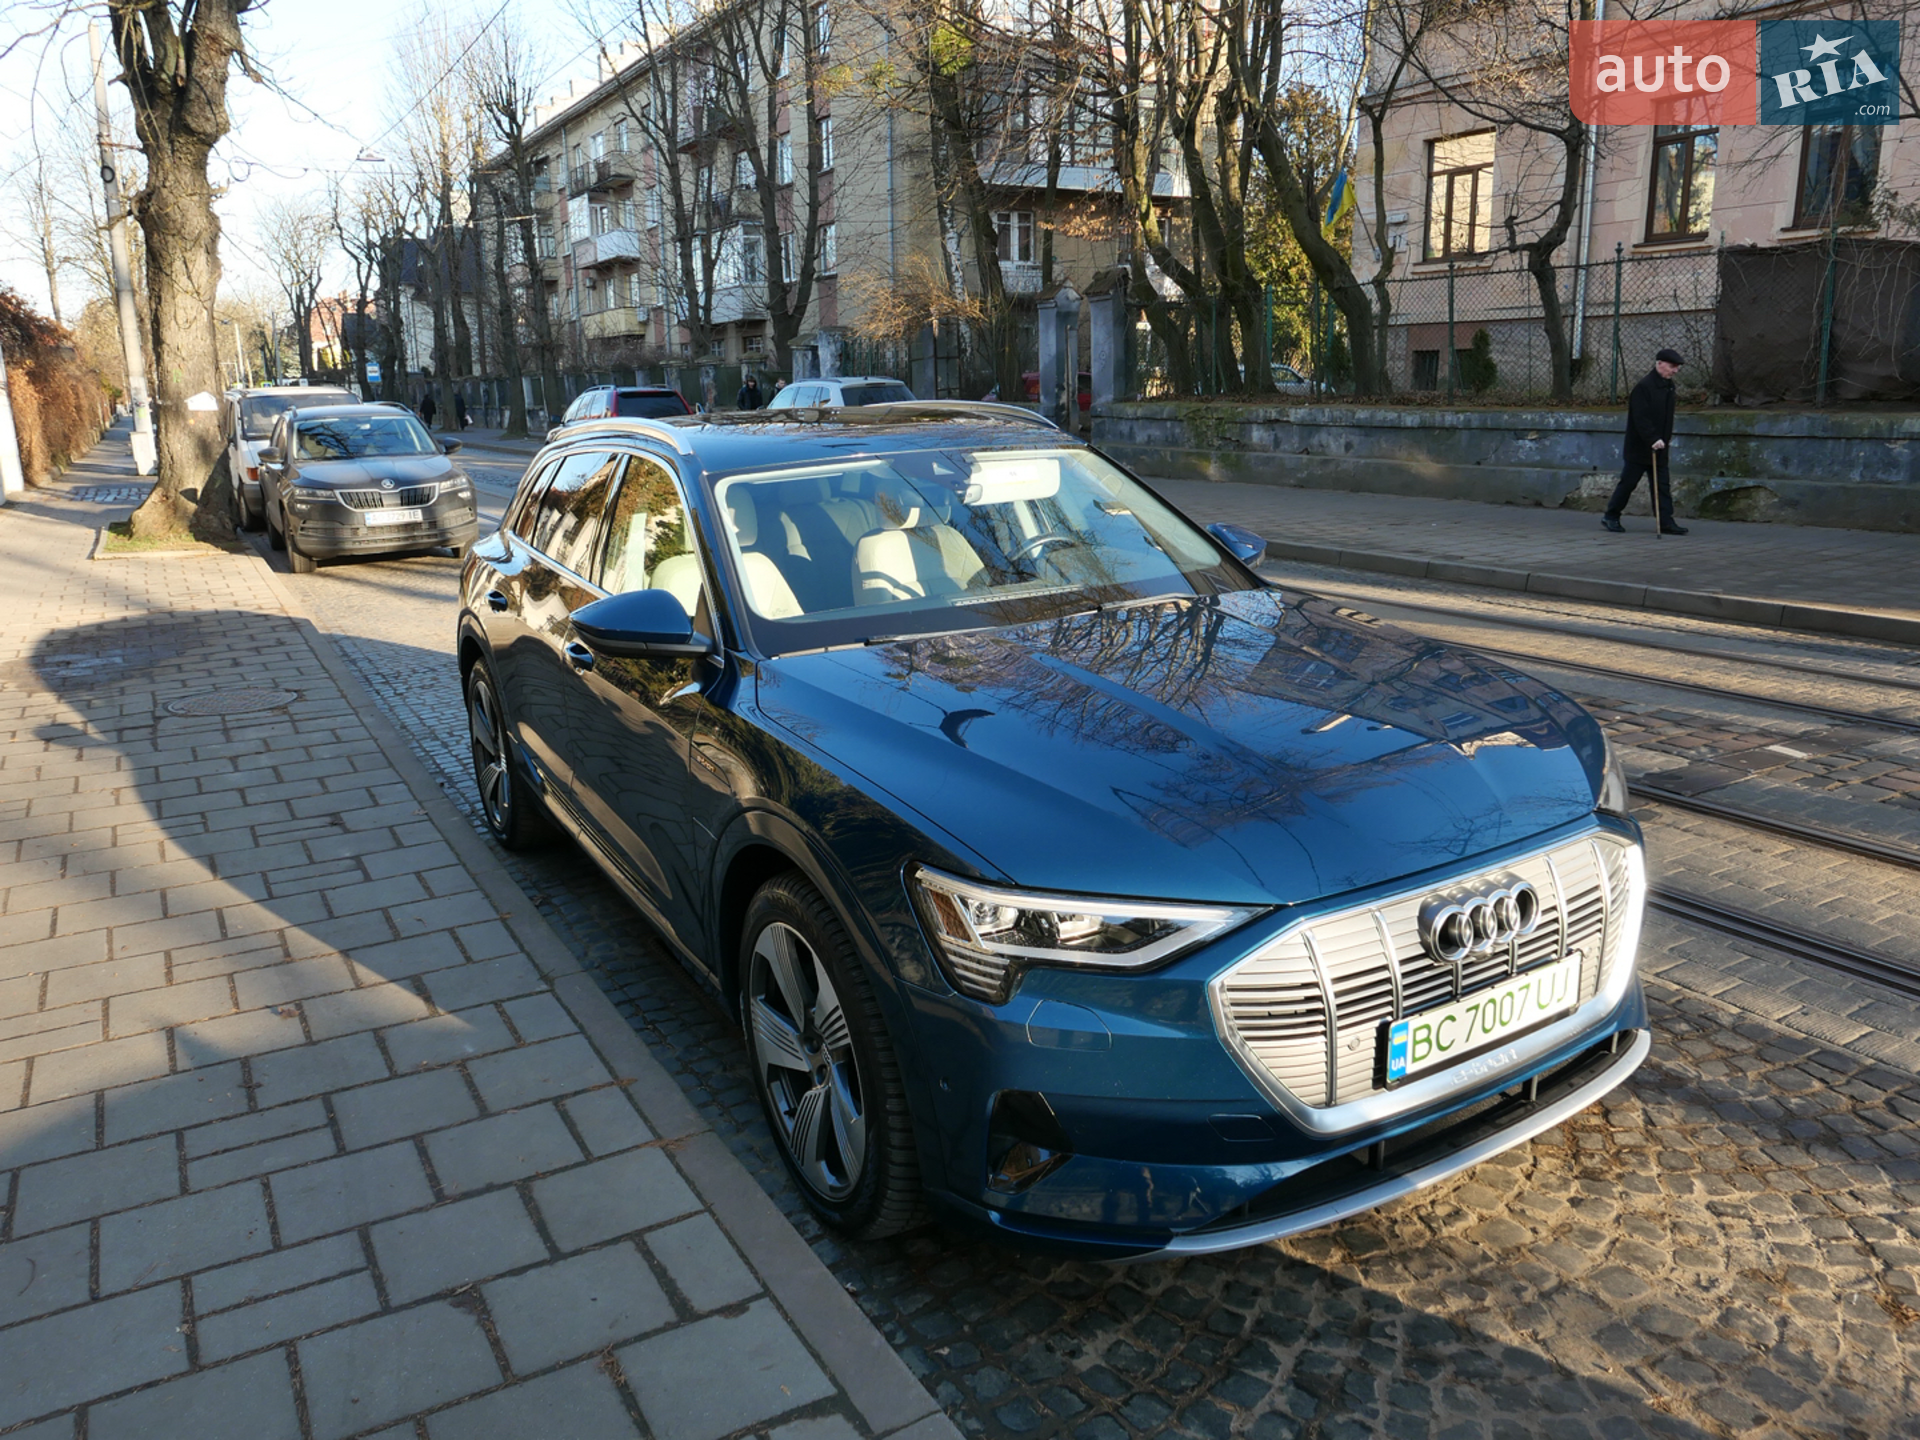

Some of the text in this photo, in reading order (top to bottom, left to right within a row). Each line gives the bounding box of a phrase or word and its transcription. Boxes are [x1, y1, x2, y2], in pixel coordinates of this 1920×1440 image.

[1411, 967, 1570, 1064] BC 7007 UJ
[1391, 1057, 1406, 1071] UA
